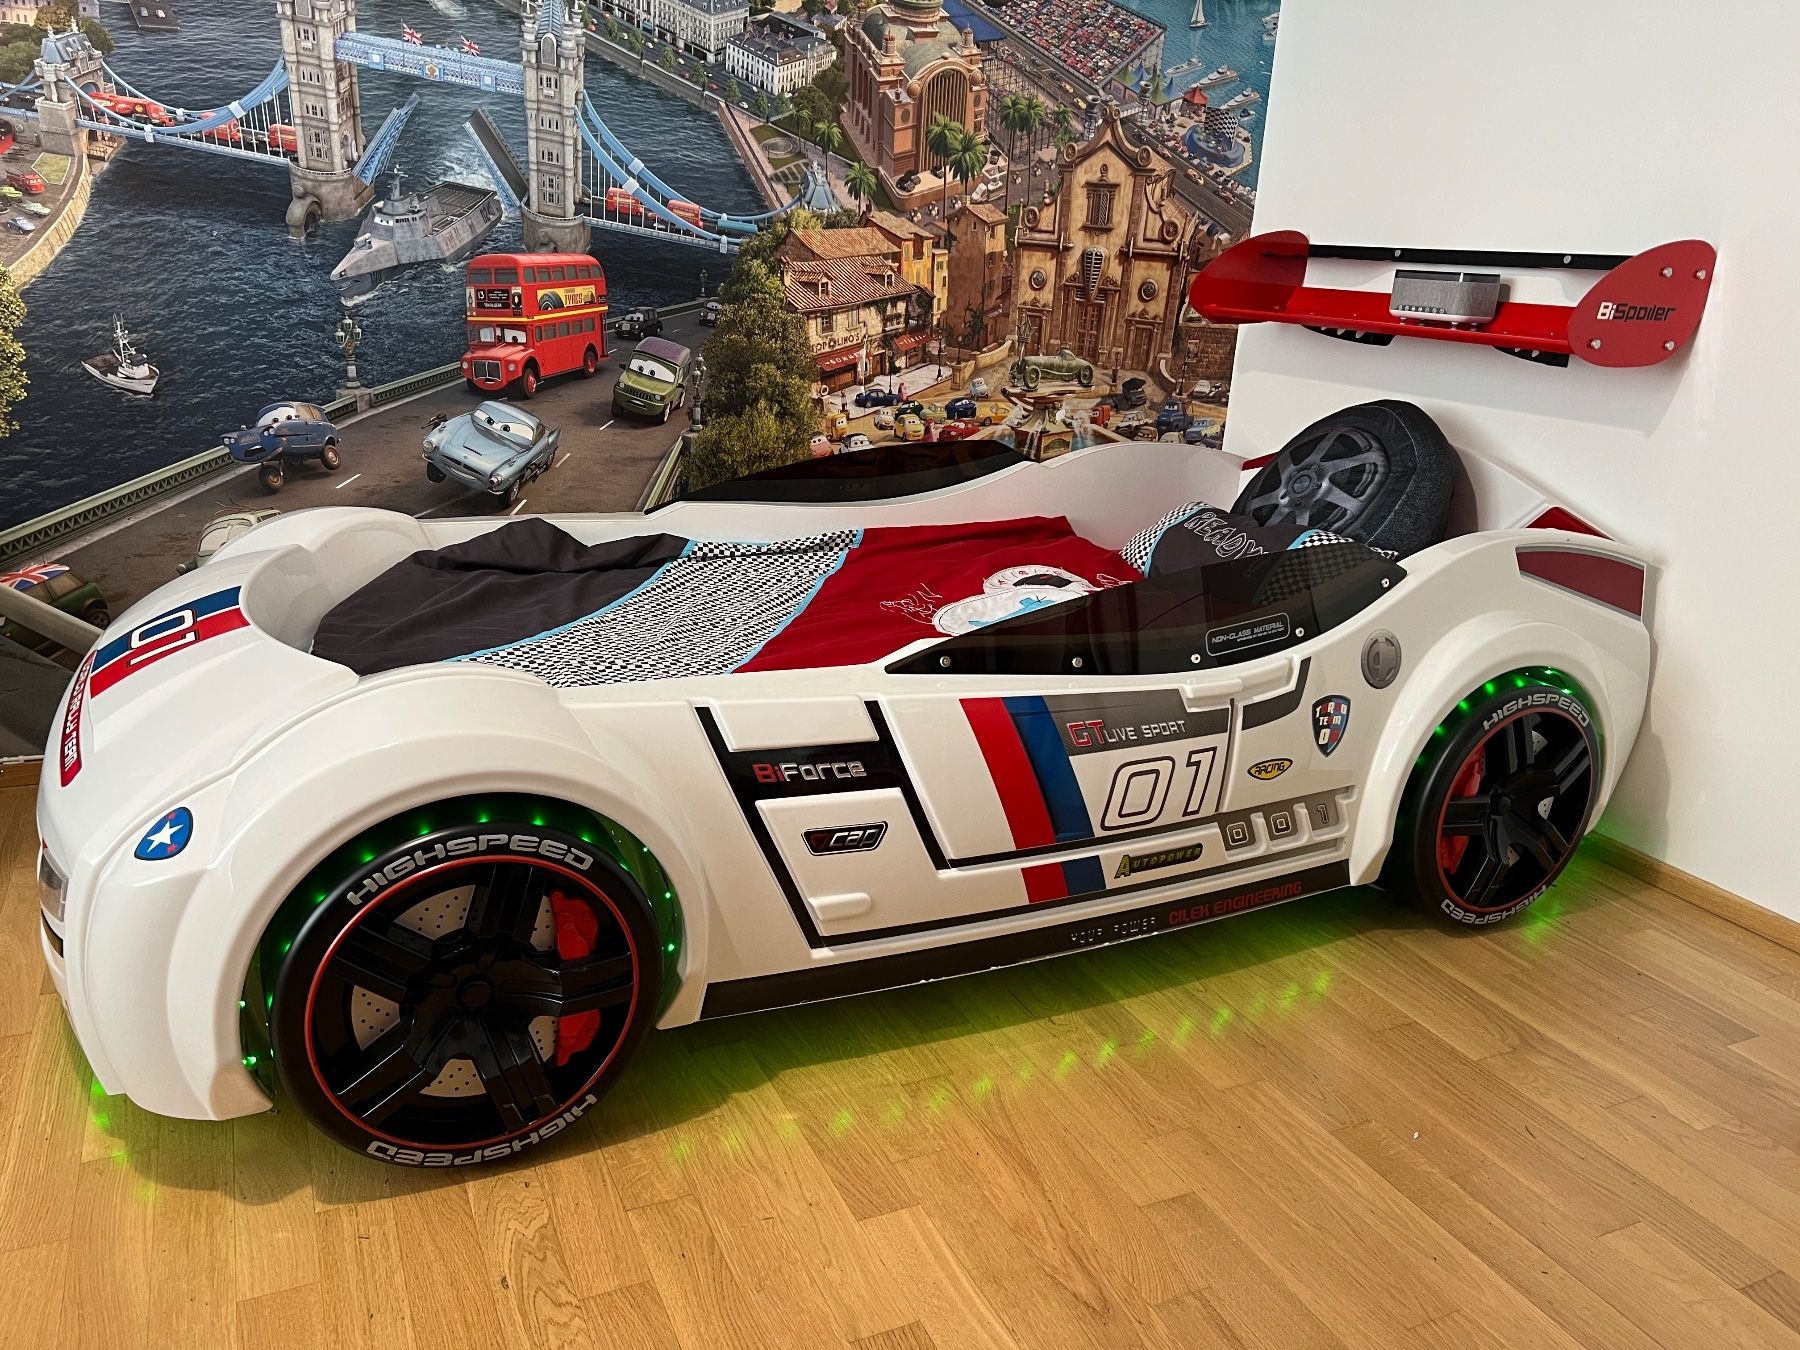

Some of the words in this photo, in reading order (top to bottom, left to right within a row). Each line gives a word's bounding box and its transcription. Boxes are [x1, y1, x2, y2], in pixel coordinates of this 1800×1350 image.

[564, 293, 583, 306] TYRES
[1597, 302, 1676, 322] BiSpoiler
[1253, 621, 1285, 634] MATERIAL
[1483, 693, 1590, 731] HIGHSPEED
[1141, 720, 1186, 738] SPORT
[752, 761, 867, 783] BiForce
[1254, 762, 1286, 776] RACING
[1100, 746, 1218, 831] 01
[347, 834, 594, 905] HIGHSPEED
[1168, 903, 1210, 925] CILEK
[1213, 880, 1303, 915] ENGINEERING
[1440, 884, 1547, 925] HIGHSPEED
[367, 1094, 598, 1168] HIGHSPEED
